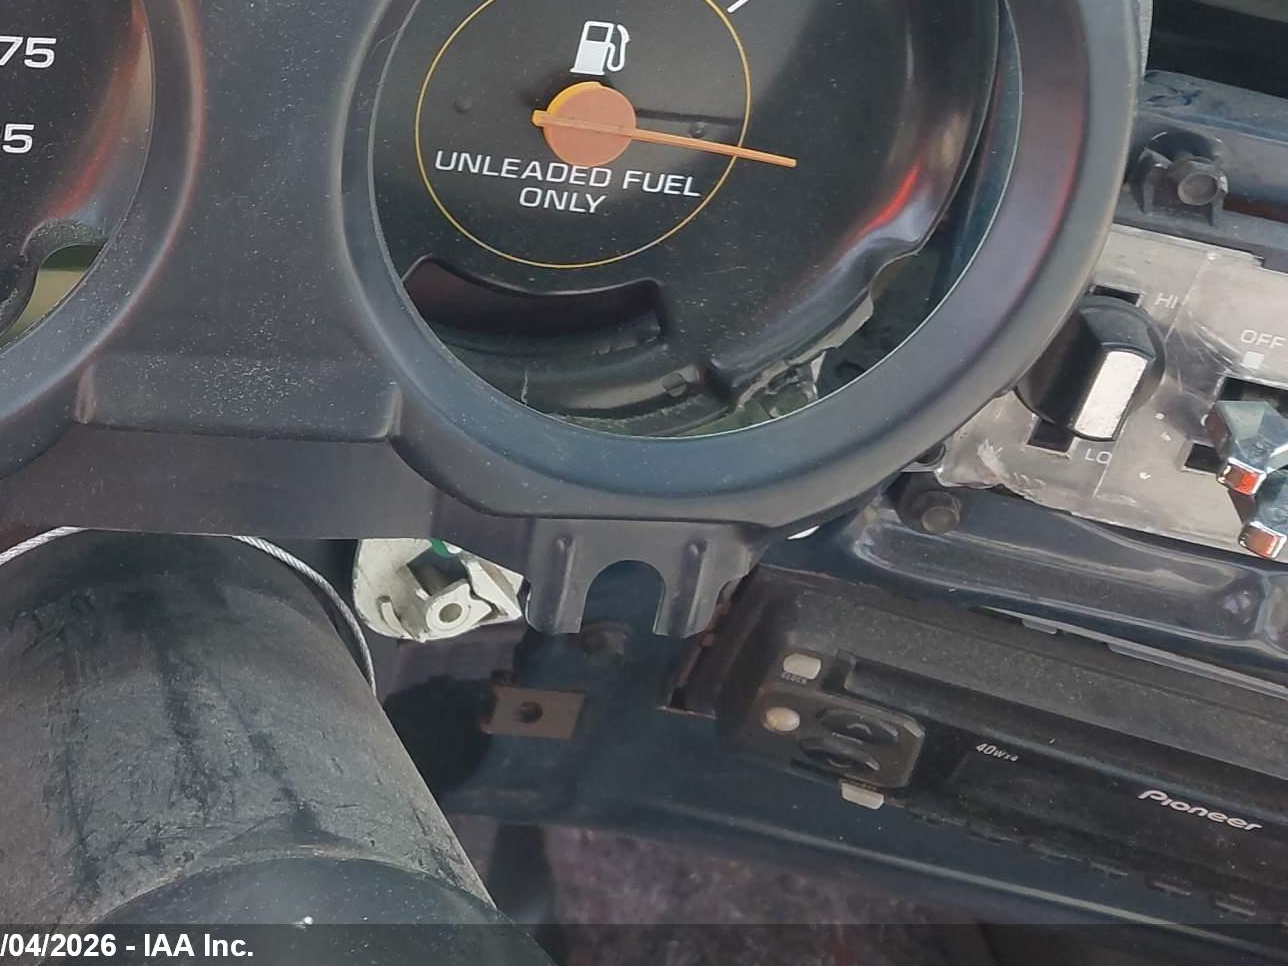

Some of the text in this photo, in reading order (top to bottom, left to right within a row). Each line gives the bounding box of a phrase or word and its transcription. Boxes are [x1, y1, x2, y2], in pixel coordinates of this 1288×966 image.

[434, 150, 702, 197] UNLEADED FUEL
[518, 187, 607, 214] ONLY
[1154, 293, 1178, 309] HI
[1240, 329, 1287, 349] OFF
[1085, 449, 1112, 465] LO
[1137, 789, 1263, 832] Pioneer
